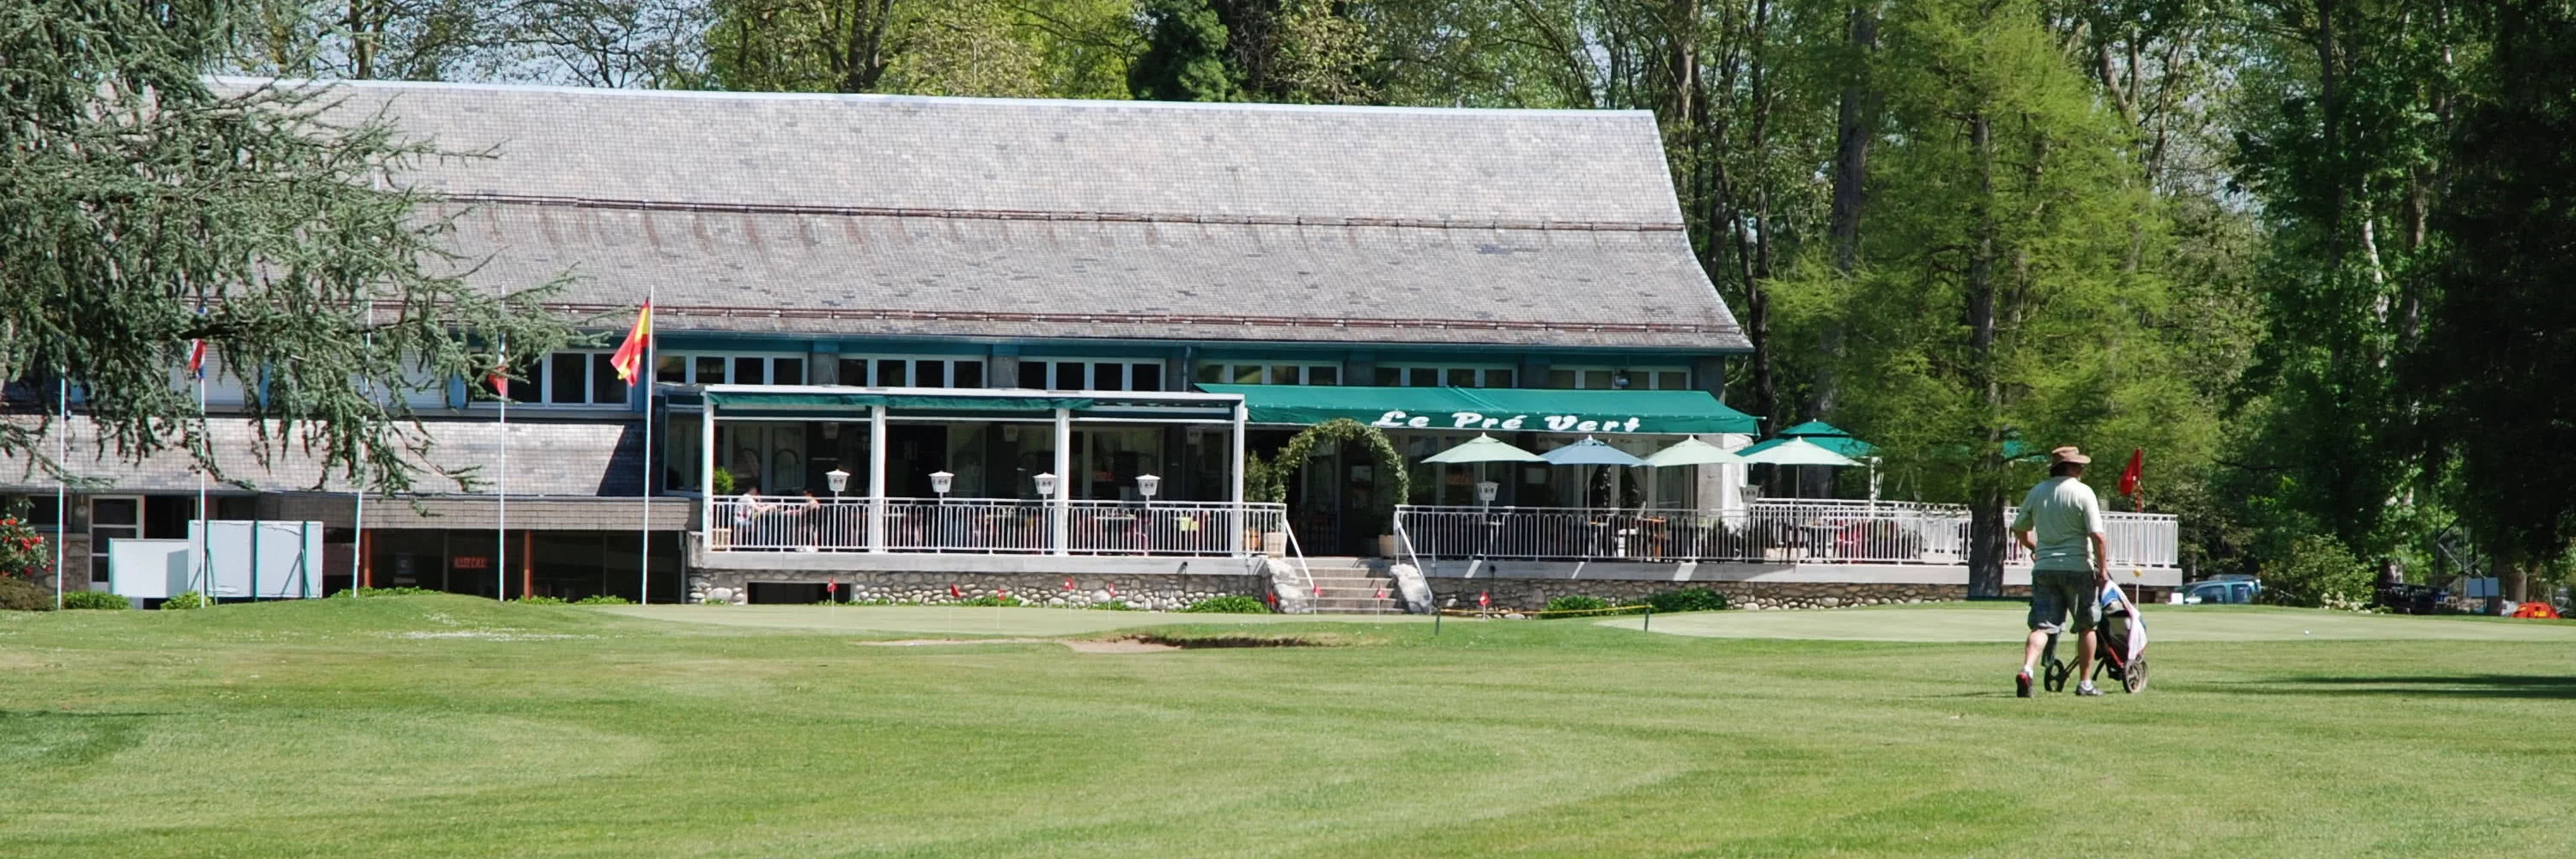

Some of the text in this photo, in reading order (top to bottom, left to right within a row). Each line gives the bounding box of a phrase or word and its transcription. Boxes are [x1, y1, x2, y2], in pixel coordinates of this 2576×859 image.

[1372, 411, 1640, 433] Le Pré Vert
